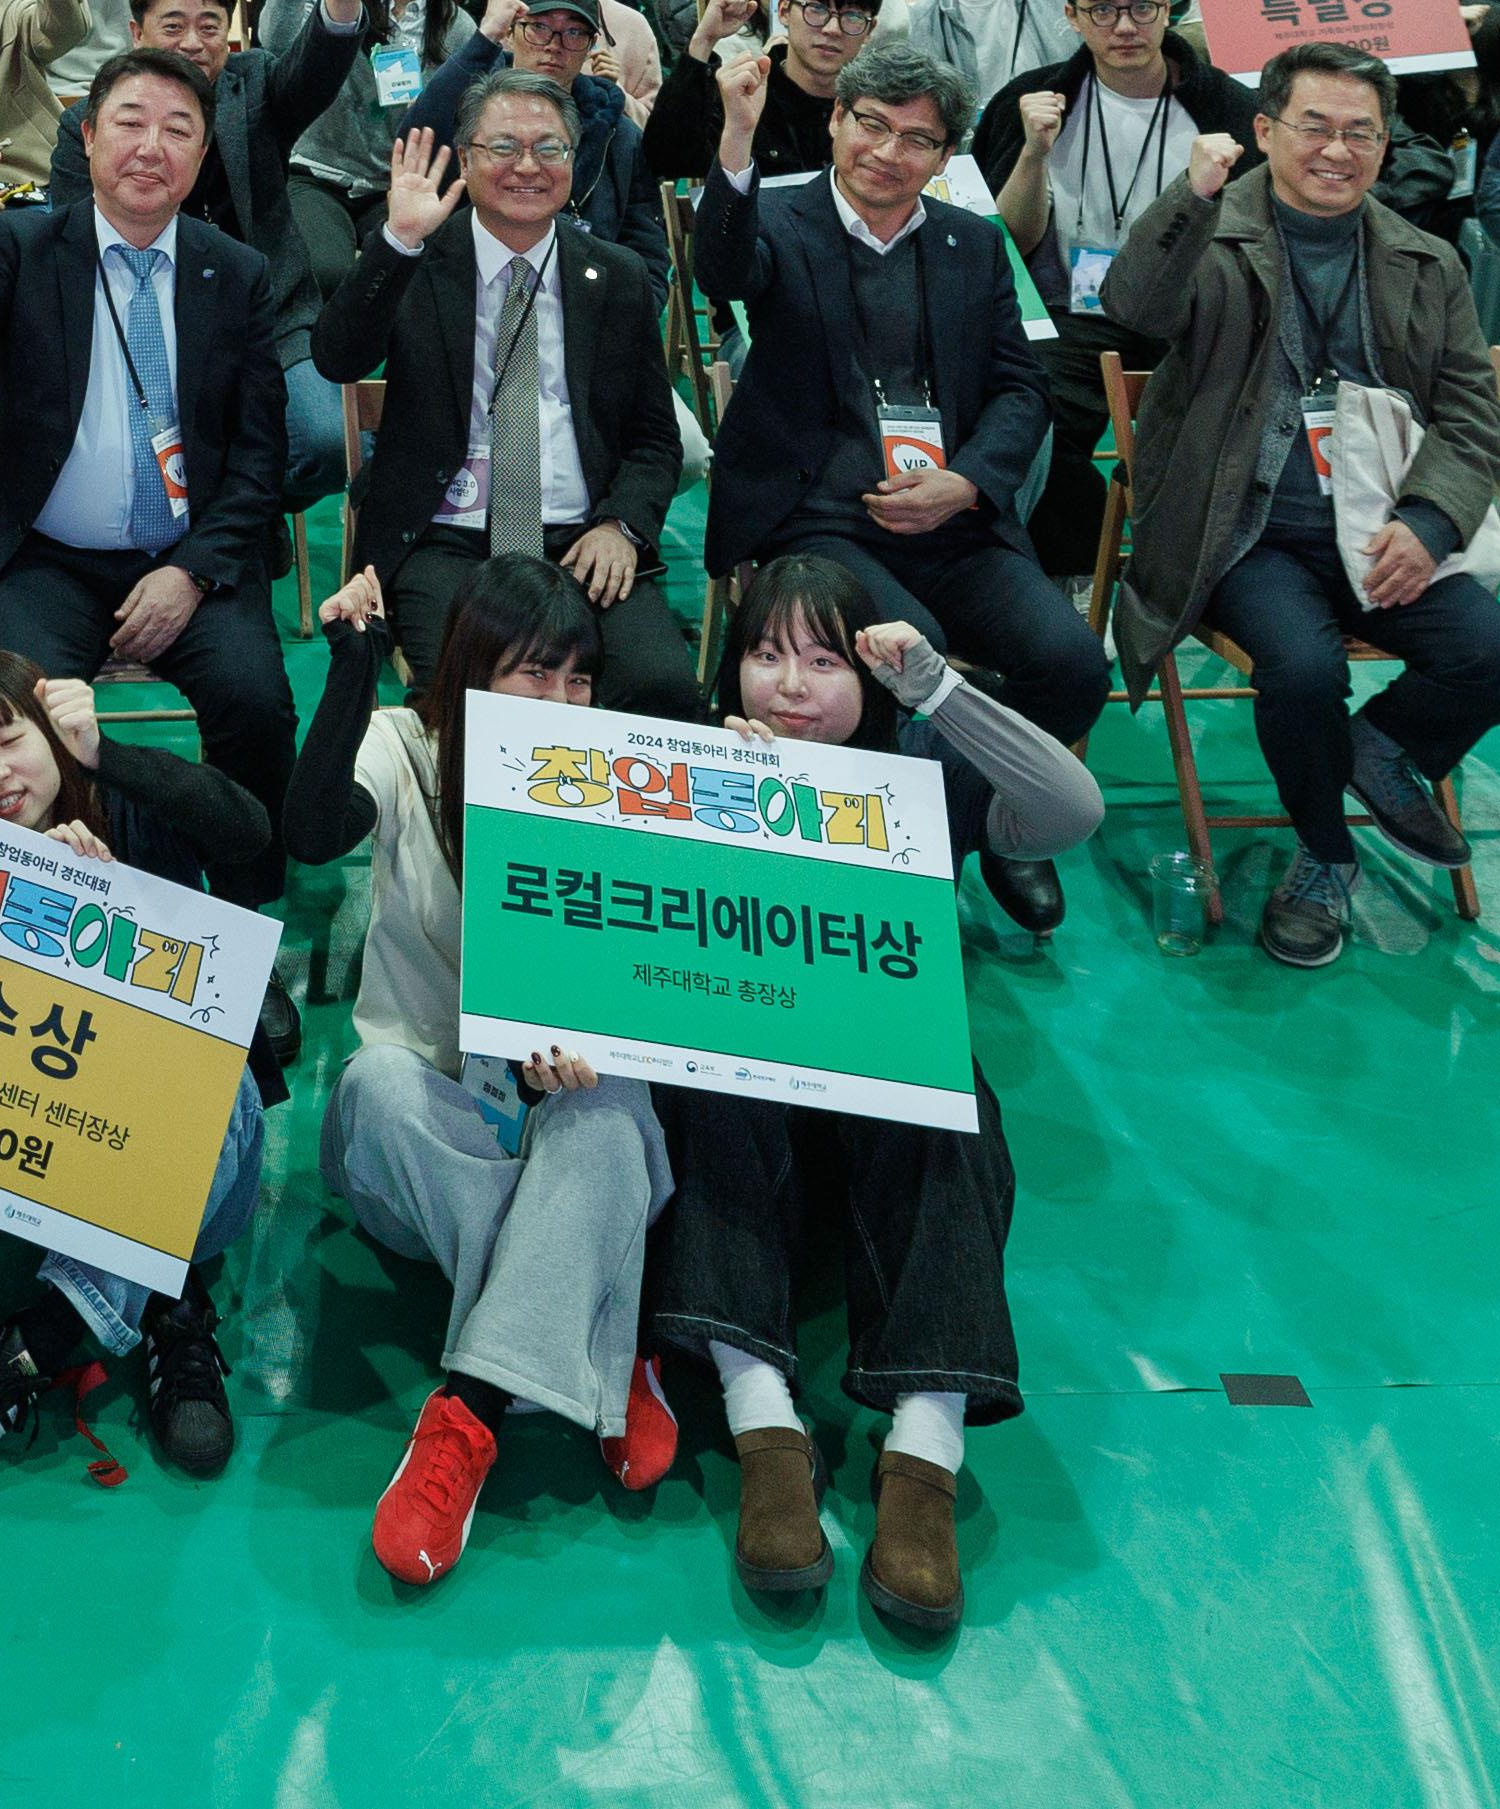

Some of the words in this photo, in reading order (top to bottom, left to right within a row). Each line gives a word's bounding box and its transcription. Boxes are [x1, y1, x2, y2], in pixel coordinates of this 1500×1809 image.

[627, 732, 664, 750] 2024
[666, 737, 729, 762] 창업동아리
[731, 746, 781, 768] 경진대회
[526, 744, 890, 853] 창업동아리
[60, 864, 111, 896] 경진대회
[501, 861, 924, 980] 로컬크리에이터상
[632, 961, 732, 1000] 제주대학교
[737, 978, 798, 1010] 총장상
[45, 1094, 131, 1151] 센터장상
